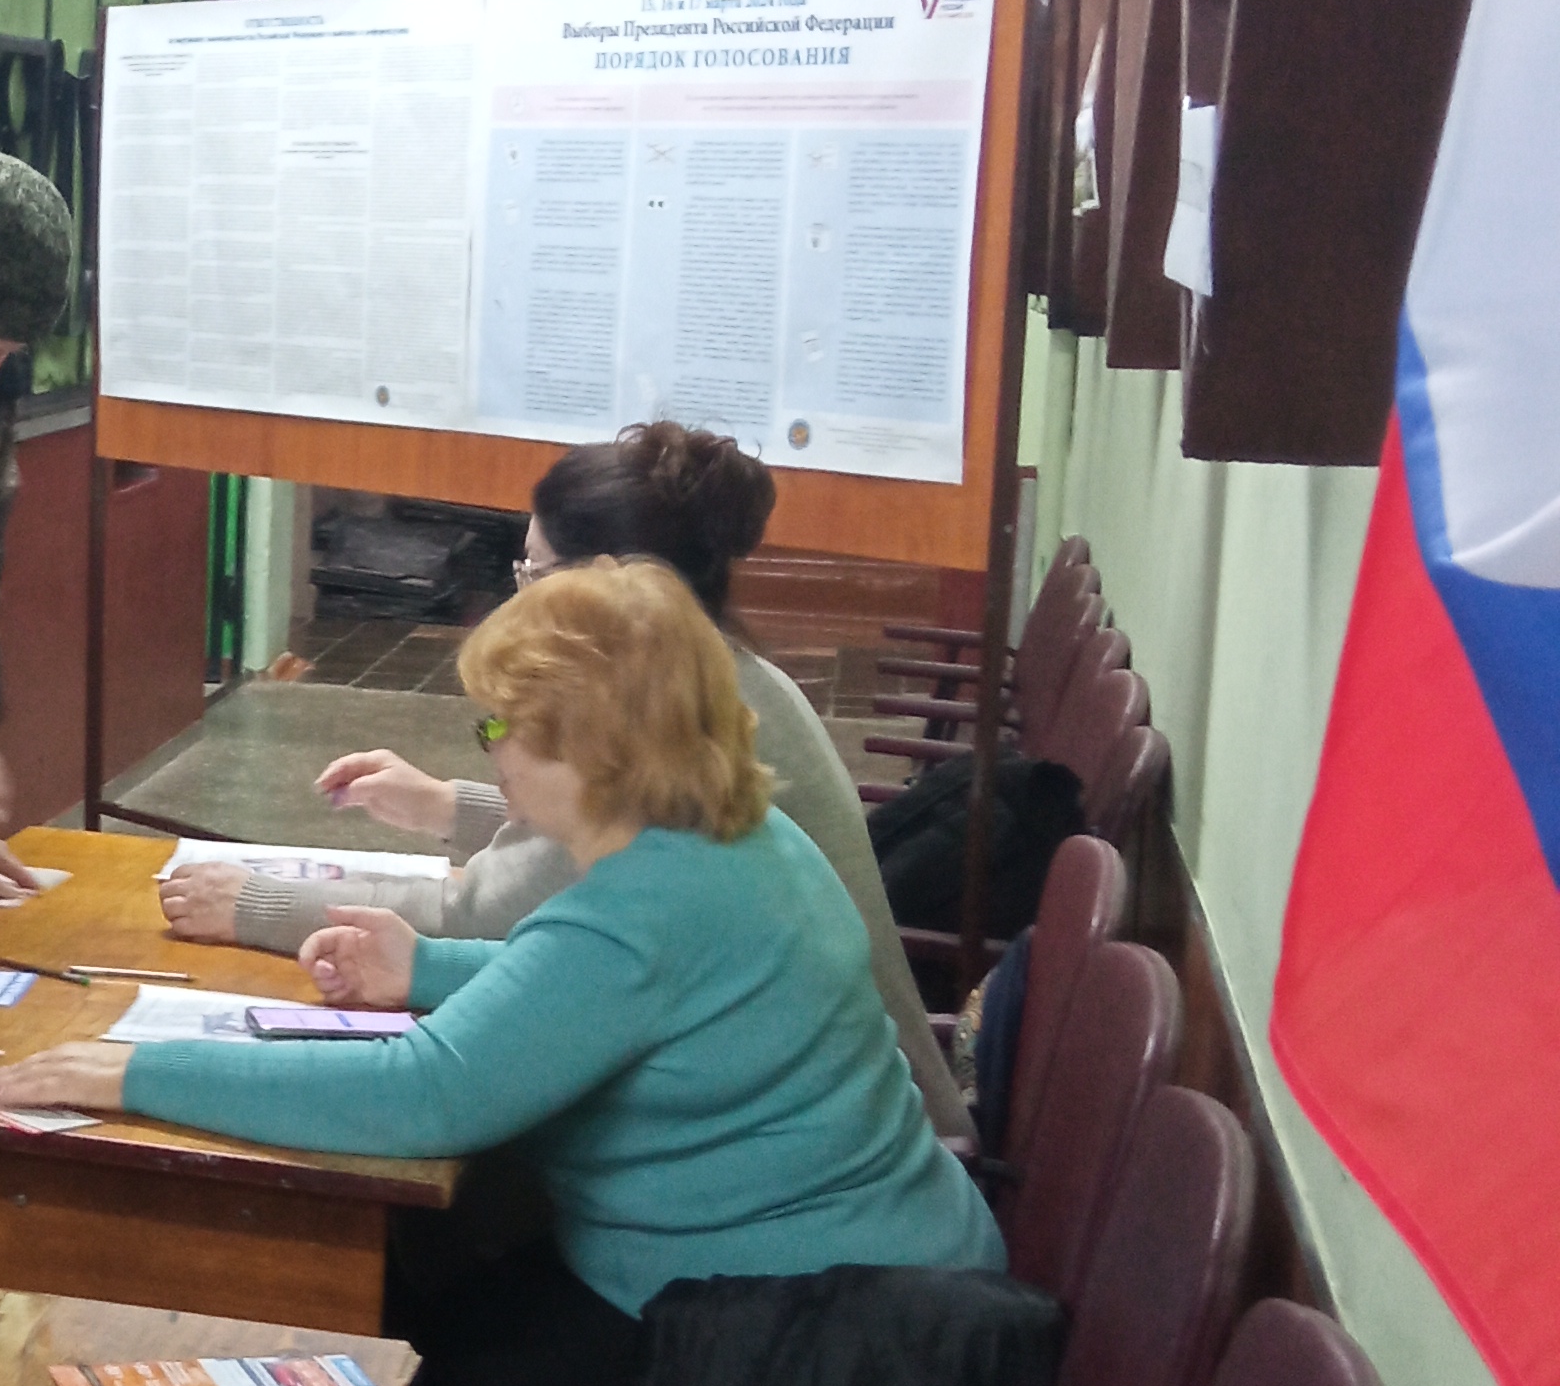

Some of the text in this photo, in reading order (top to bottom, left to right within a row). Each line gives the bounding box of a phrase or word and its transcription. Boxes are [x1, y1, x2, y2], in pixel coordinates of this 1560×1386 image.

[562, 14, 895, 42] Выборы Президента Российской Федерации
[595, 46, 852, 70] ПОРЯДОК ГОЛОСОВАНИЯ
